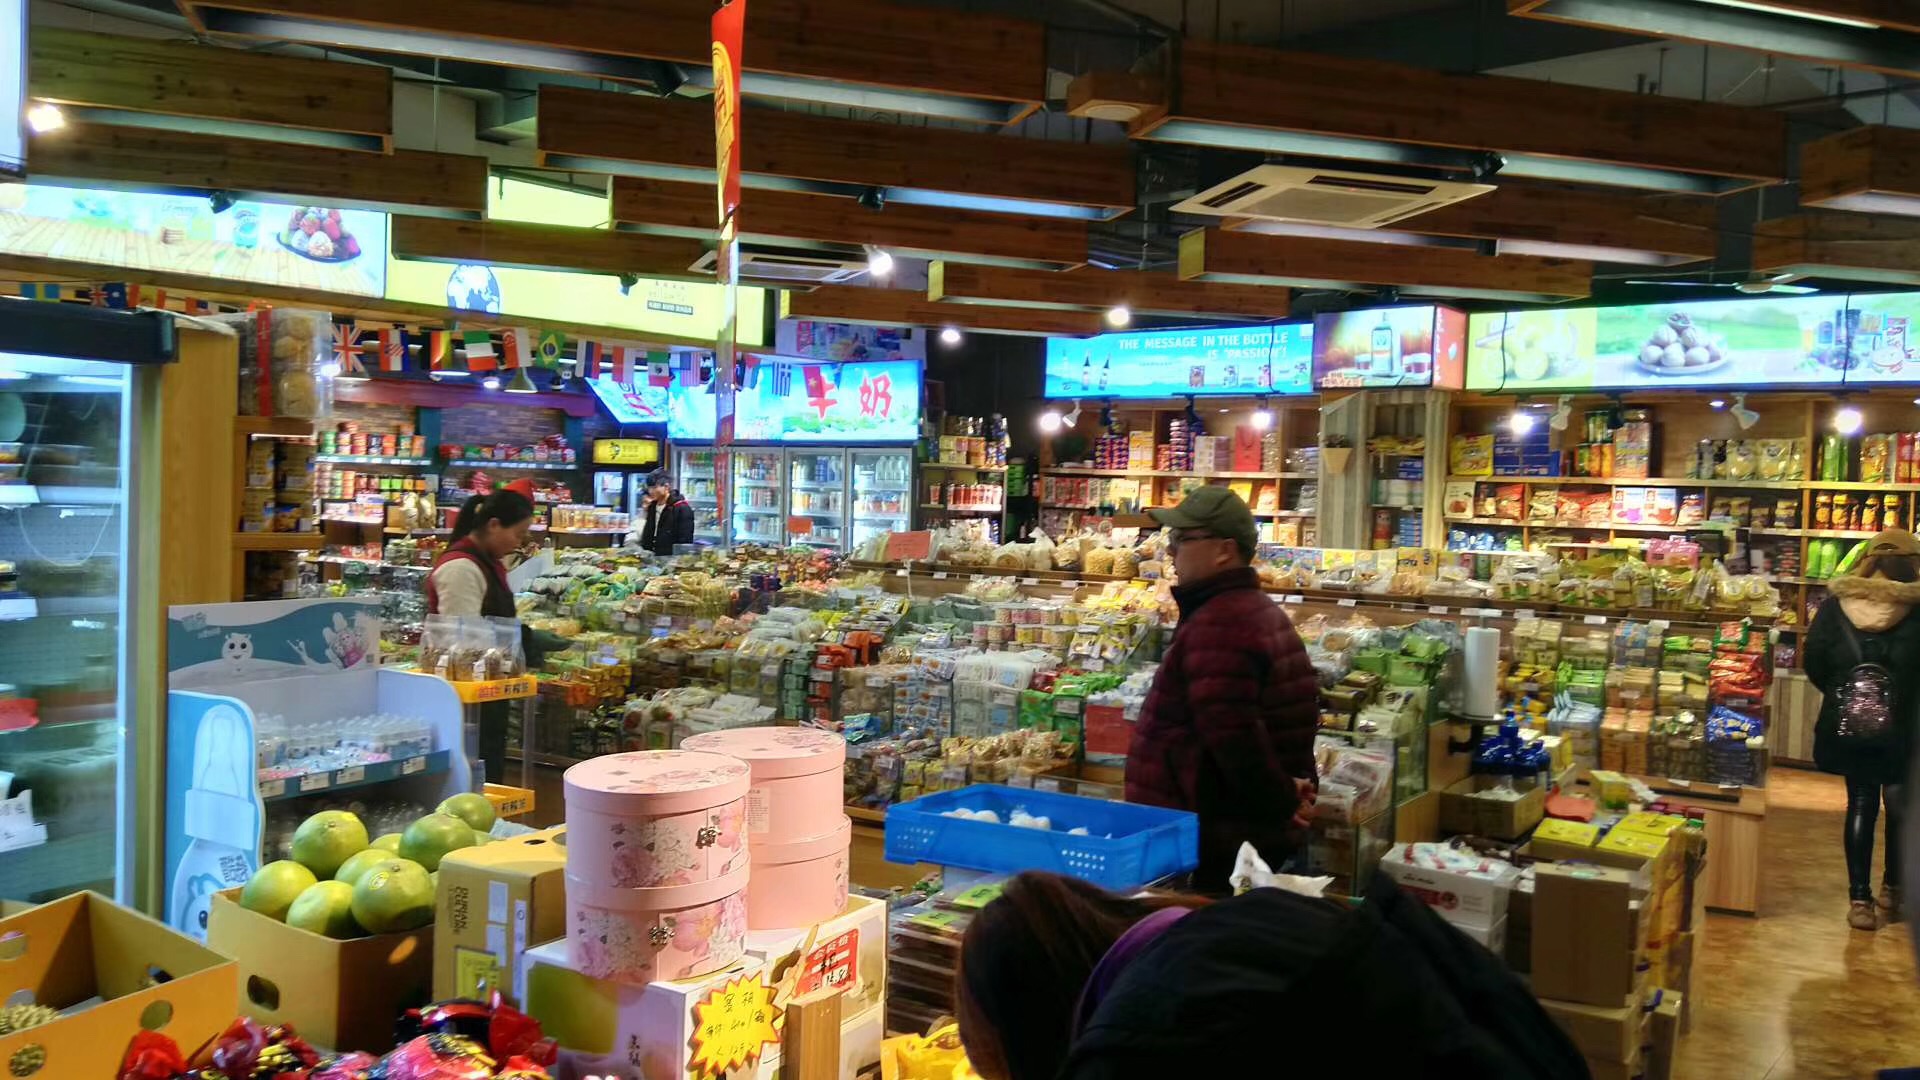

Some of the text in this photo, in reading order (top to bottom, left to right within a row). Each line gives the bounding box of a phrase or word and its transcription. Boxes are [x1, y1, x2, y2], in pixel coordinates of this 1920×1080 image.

[1119, 332, 1288, 350] THE MESSAGE IN THE BOTTLE
[1207, 349, 1218, 360] IS
[460, 887, 469, 930] DURIAN
